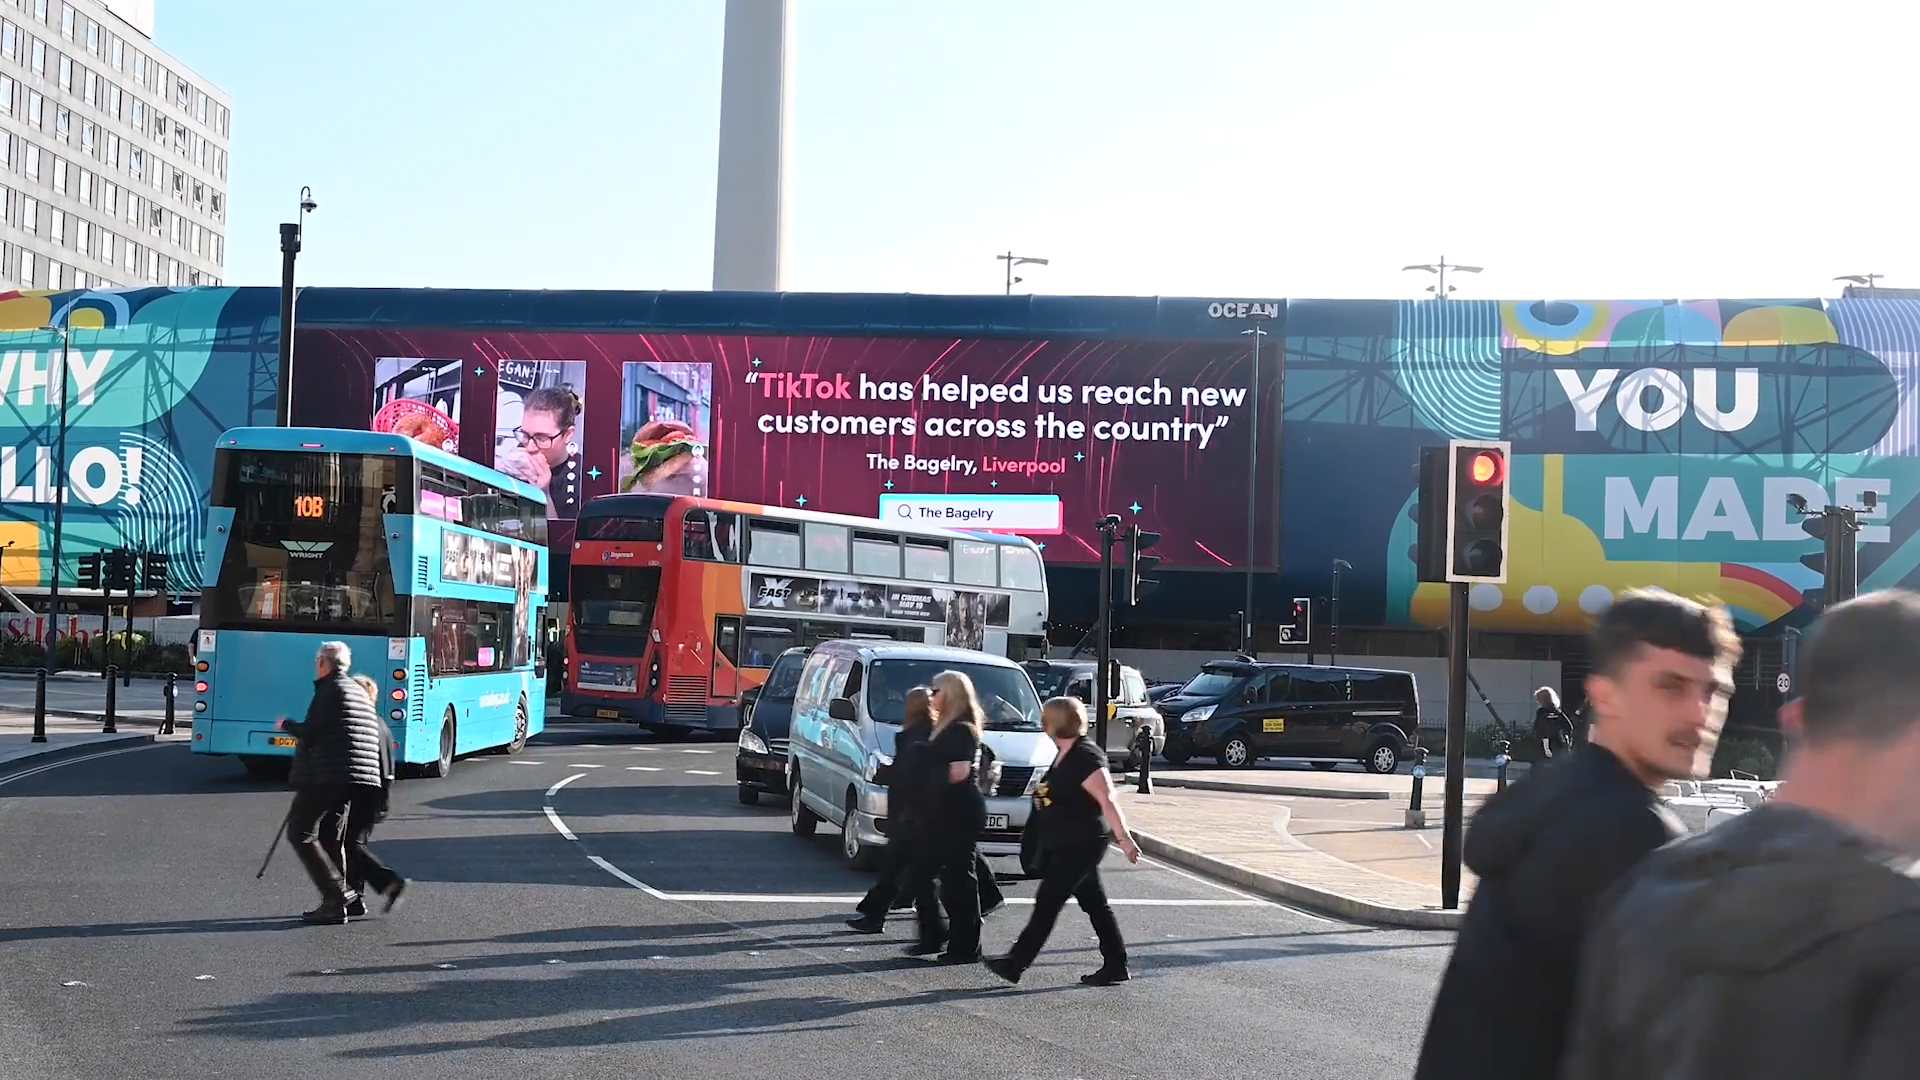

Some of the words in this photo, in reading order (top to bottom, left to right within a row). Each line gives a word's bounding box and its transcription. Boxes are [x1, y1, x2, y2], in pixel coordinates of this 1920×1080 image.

[1208, 302, 1278, 319] OCEAN
[859, 373, 914, 400] has
[923, 374, 1029, 410] helped
[1038, 384, 1073, 404] us
[1082, 378, 1172, 405] reach
[1181, 386, 1247, 407] new
[1553, 367, 1759, 432] YOU
[757, 410, 917, 436] customers
[924, 417, 1027, 438] across
[1034, 411, 1085, 439] the
[1093, 415, 1230, 450] country”
[866, 453, 900, 470] The
[904, 455, 978, 476] Bagelry,
[982, 456, 1066, 477] Liverpool
[293, 496, 324, 517] 10B
[918, 507, 942, 518] The
[945, 507, 994, 521] Bagelry
[1604, 475, 1891, 543] MADE
[289, 551, 324, 559] WRIGHT
[758, 586, 792, 600] FAST
[900, 594, 932, 604] CINEMAS
[899, 600, 915, 609] MAY
[1778, 678, 1789, 688] 20
